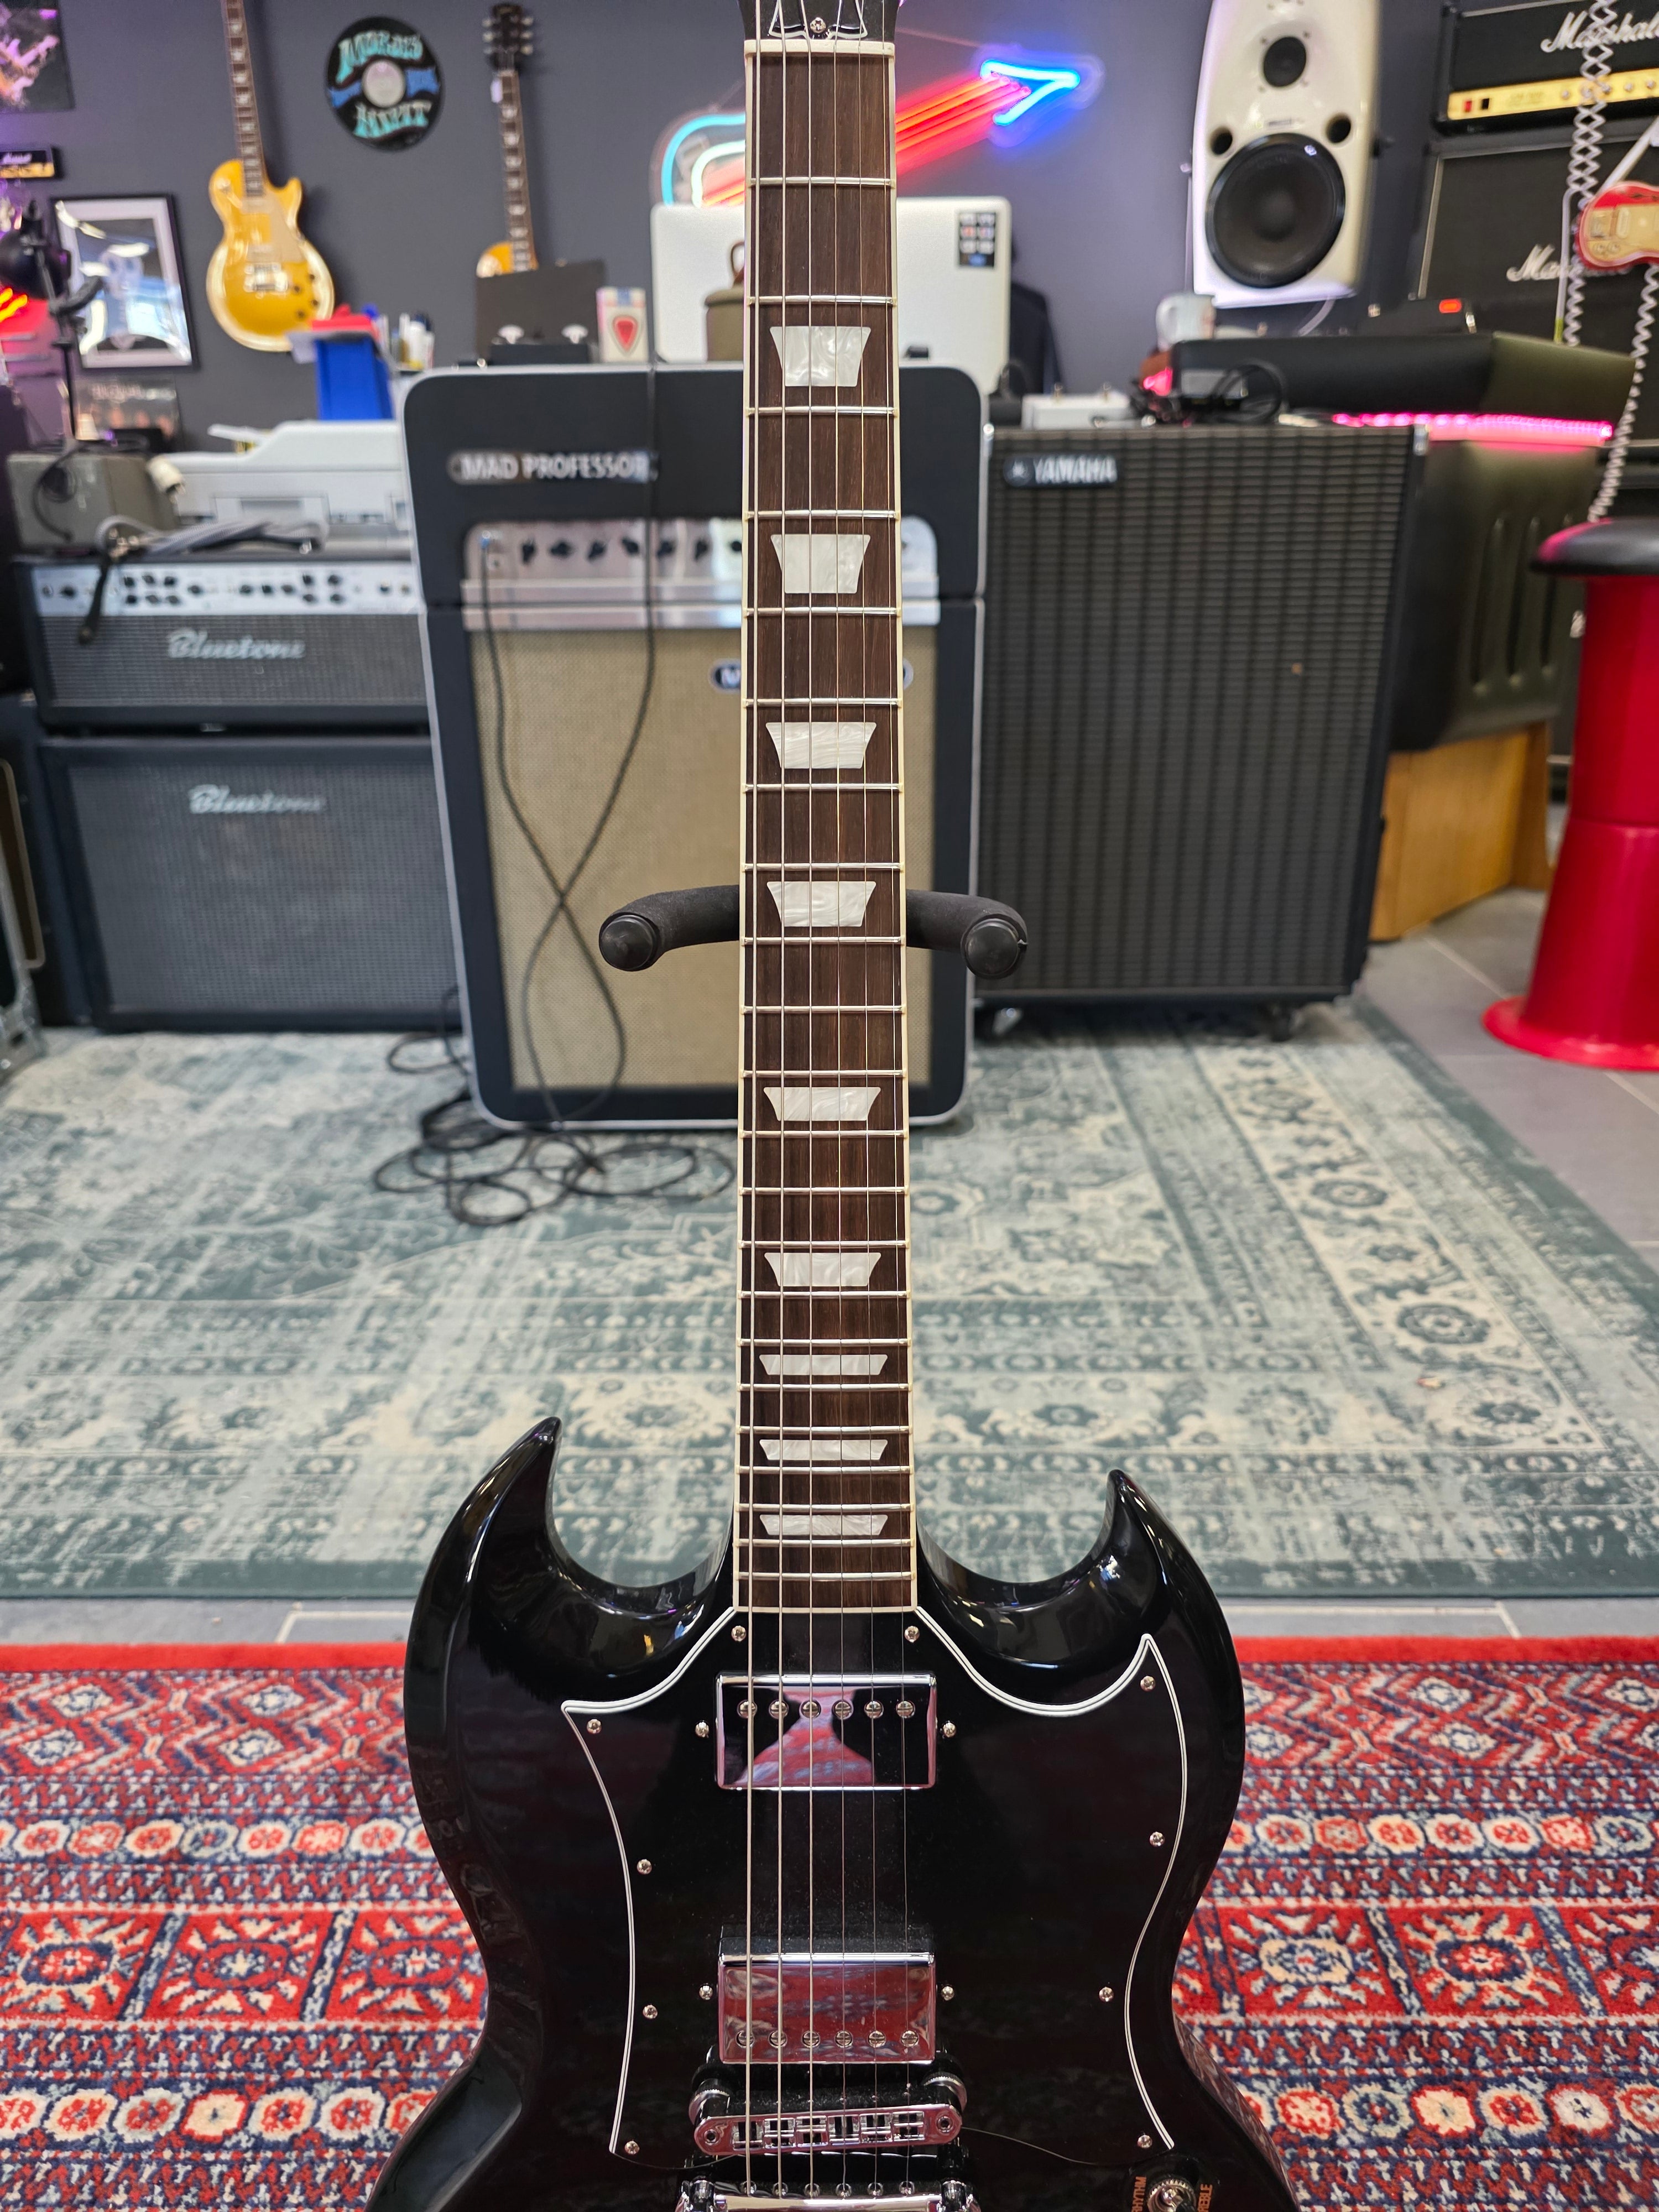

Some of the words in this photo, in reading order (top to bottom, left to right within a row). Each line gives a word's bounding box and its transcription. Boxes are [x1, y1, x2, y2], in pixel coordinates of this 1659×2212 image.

[461, 453, 519, 480] MAD
[521, 452, 649, 481] PROFESSOR
[1032, 455, 1118, 483] YAMAHA
[168, 628, 306, 659] Bluetone
